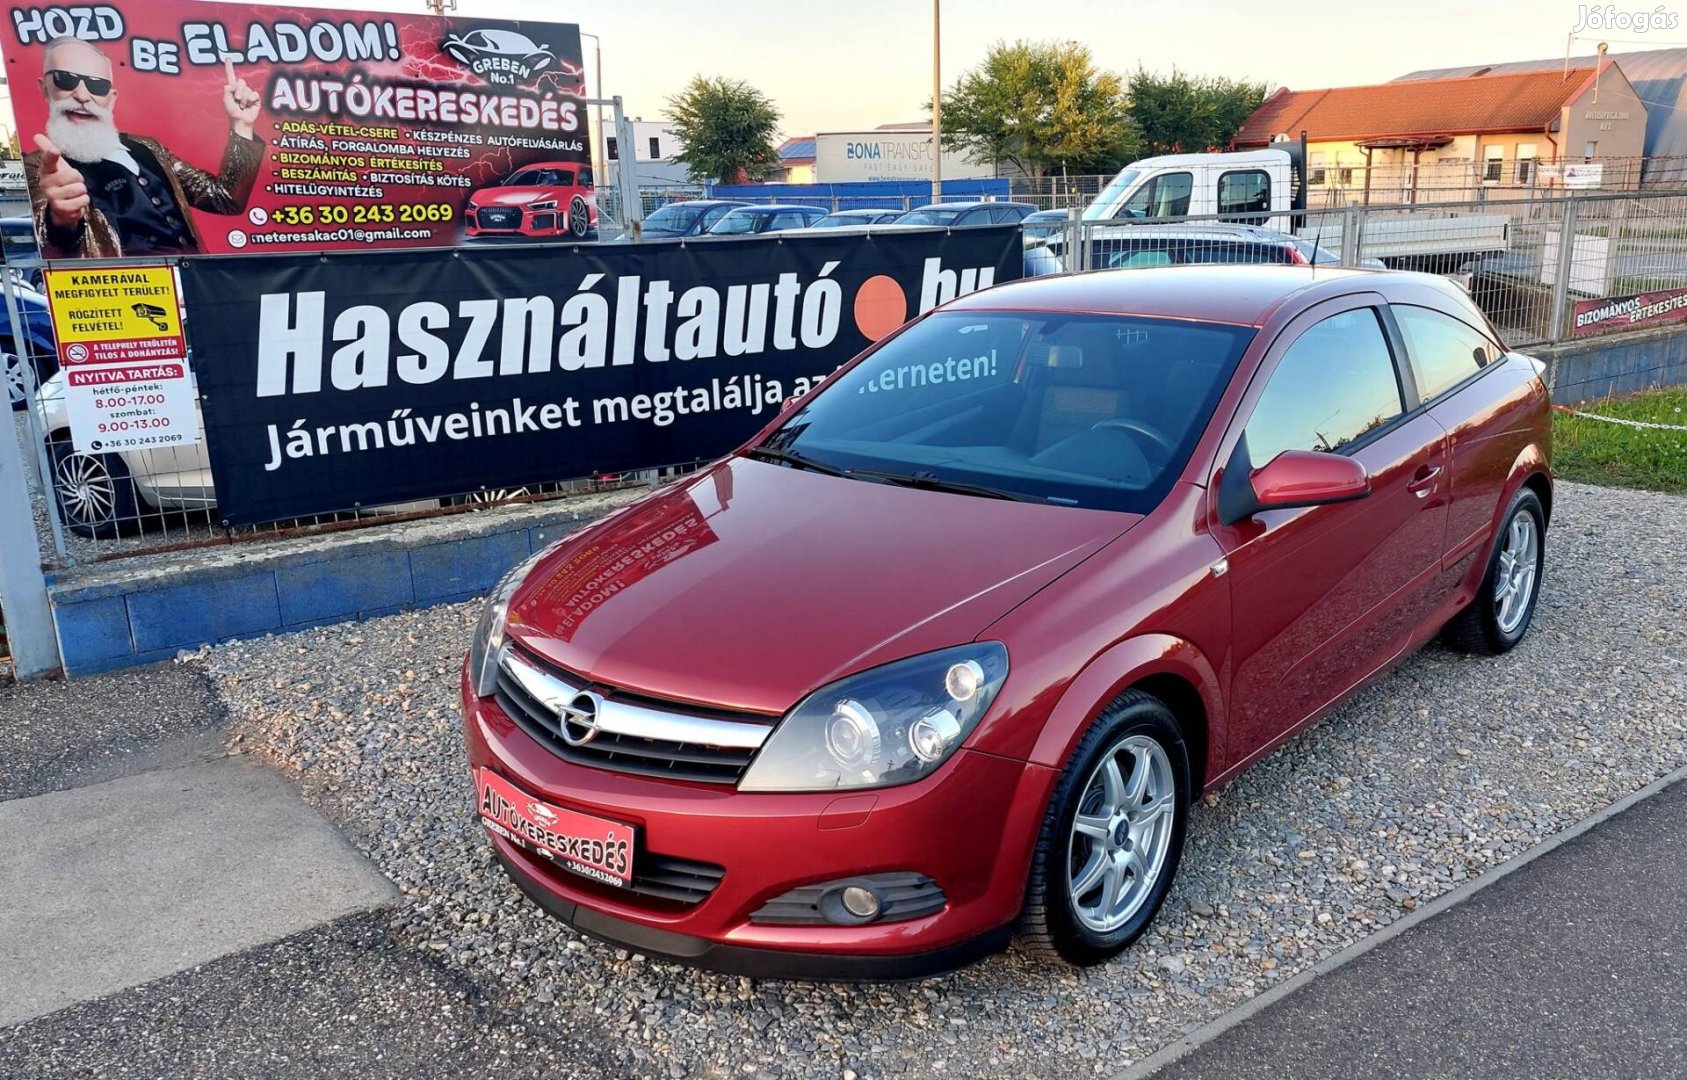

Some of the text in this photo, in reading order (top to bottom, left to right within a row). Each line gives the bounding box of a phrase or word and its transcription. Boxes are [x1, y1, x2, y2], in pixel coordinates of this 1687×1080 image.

[14, 6, 400, 74] HOZD BE ELADOM!
[472, 57, 530, 79] GREBEN
[490, 71, 515, 85] No.1
[272, 74, 579, 132] AUTÓKERESKEDÉS
[282, 122, 584, 152] ADÁS-VÉTEL-CSERE KÉSZPÉNZES AUTÓFELVÁSÁRLÁS
[280, 136, 471, 159] ÁTÍRÁS, FORGALOMBA HELYEZÉS
[280, 152, 444, 171] BIZOMÁNYOS ÉRTÉKESÍTÉS
[281, 168, 471, 187] BESZÁMÍTÁS BIZTOSÍTÁS KÖTÉS
[274, 183, 384, 198] HITELÜGYINTÉZÉS
[271, 204, 453, 224] +36 30 243 2069
[72, 272, 149, 285] KAMERÁVAL
[55, 285, 170, 299] MEGFIGYELT TERÜLET!
[69, 308, 122, 320] RÖGZÍTETT
[72, 320, 123, 332] FELVÉTEL!
[100, 341, 138, 351] TELEPHELY
[140, 338, 177, 348] TERÜLETÉN
[95, 351, 118, 360] TILOS
[128, 347, 179, 358] DOHÁNYZÁS!
[74, 366, 178, 384] NYITVA TARTÁS:
[93, 383, 163, 396] hétfő-péntek:
[95, 394, 165, 409] 8.00-17.00
[110, 409, 156, 419] szombat:
[98, 417, 170, 433] 9.00-13.00
[265, 397, 581, 472] Járműveinket
[593, 374, 783, 427] megtalálja
[105, 434, 182, 448] +36 30 243 2069
[482, 783, 628, 875] AUTÓKERESKEDÉS
